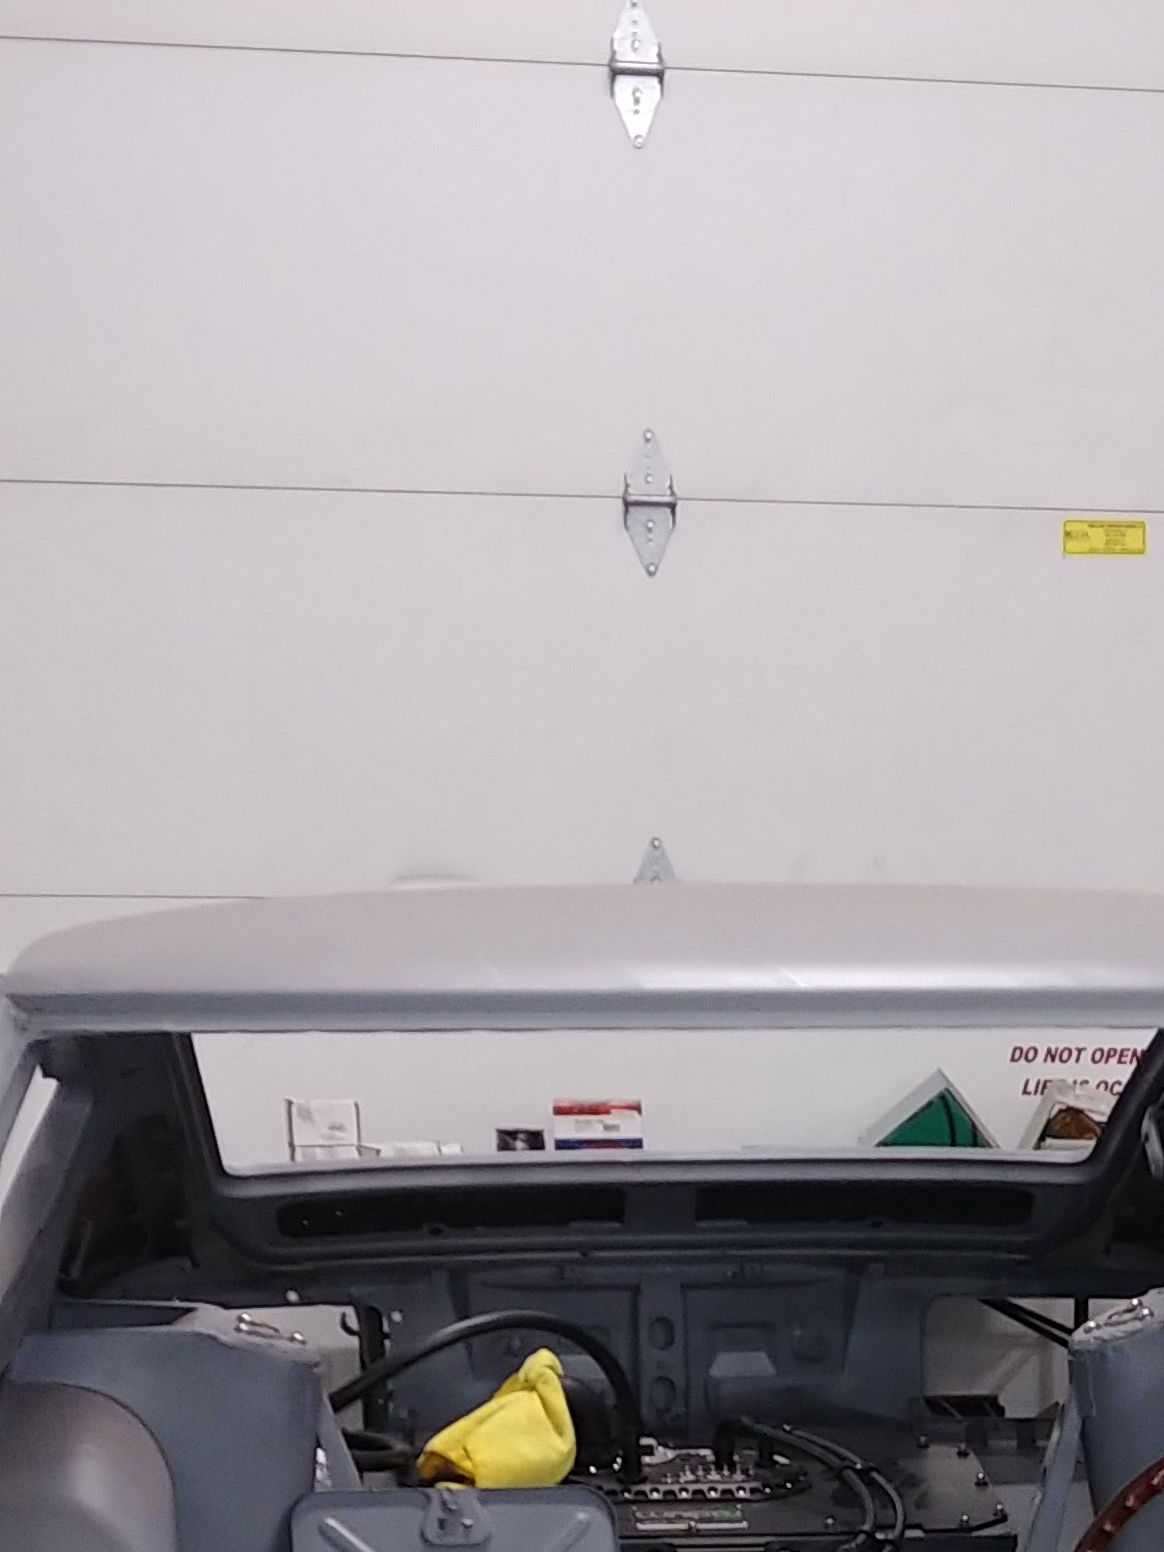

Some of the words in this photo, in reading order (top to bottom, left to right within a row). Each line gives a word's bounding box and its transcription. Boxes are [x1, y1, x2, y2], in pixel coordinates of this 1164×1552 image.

[1009, 1046, 1038, 1063] DO
[1043, 1046, 1087, 1063] NOT
[1022, 1079, 1053, 1096] LIF
